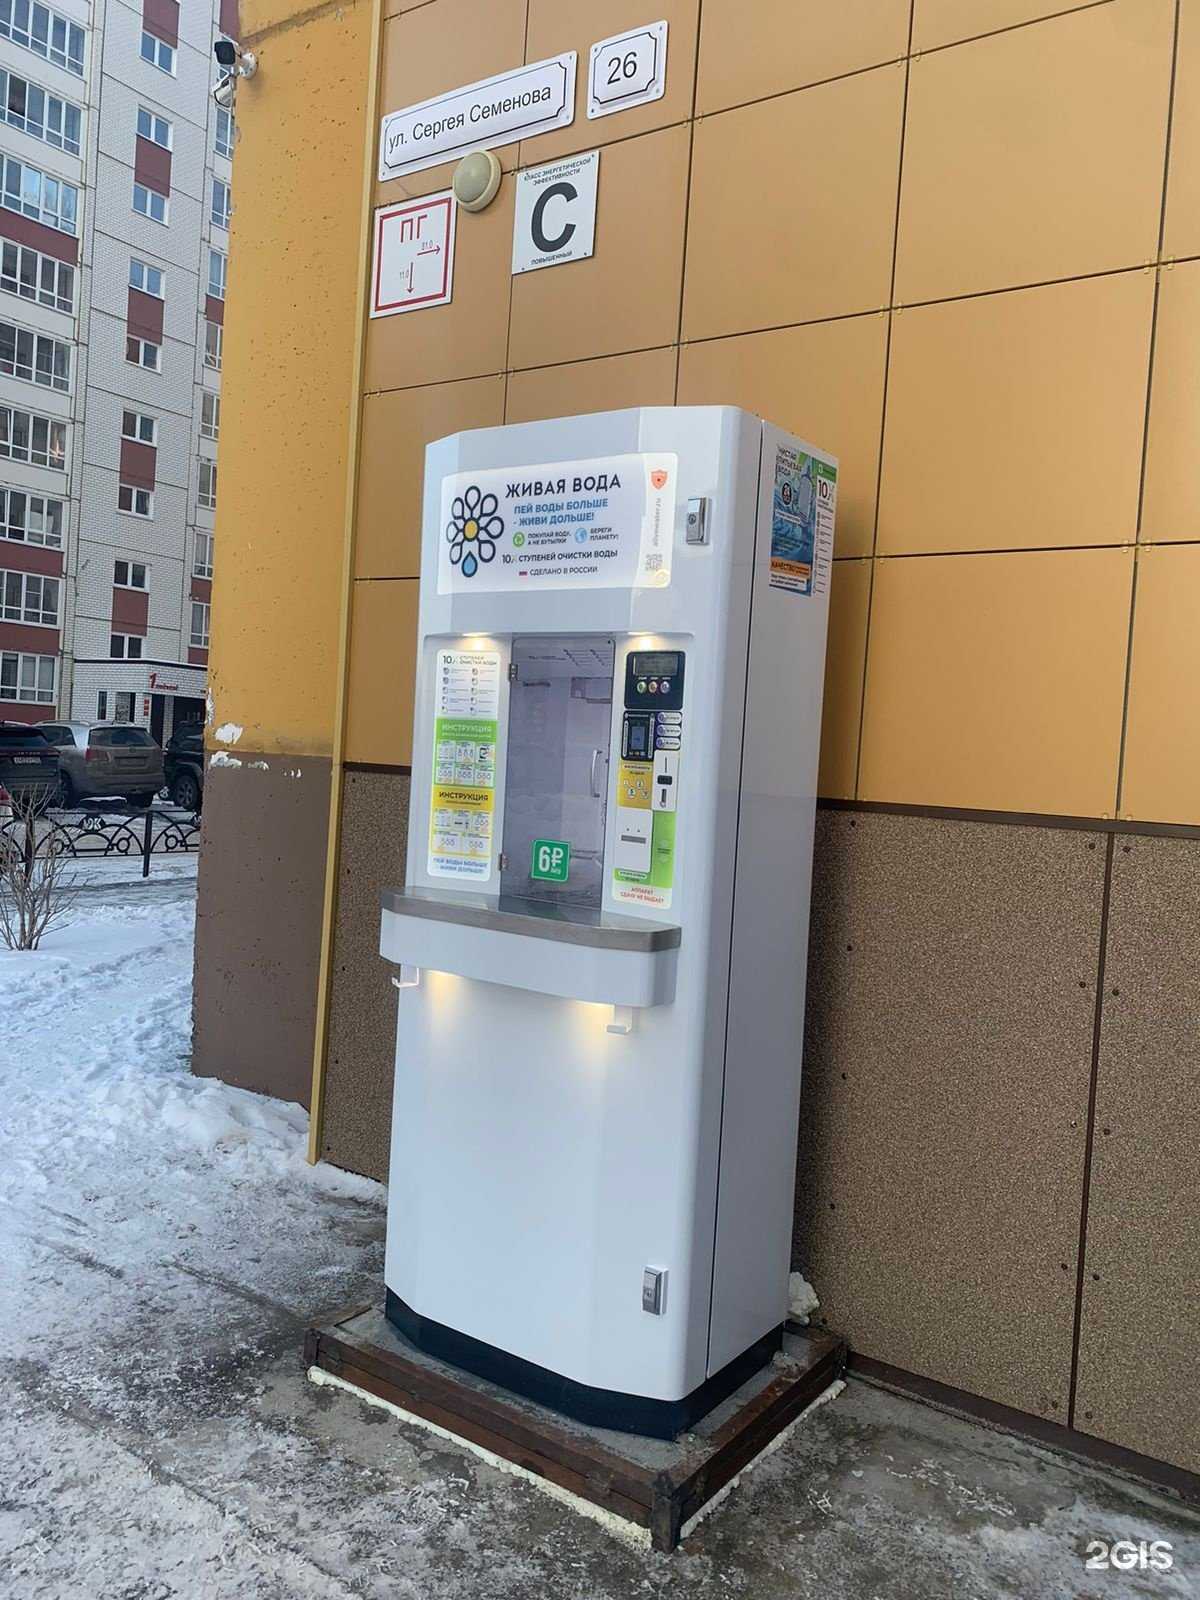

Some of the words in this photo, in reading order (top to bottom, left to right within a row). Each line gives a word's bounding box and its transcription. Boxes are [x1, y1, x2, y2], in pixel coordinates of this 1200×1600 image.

[607, 51, 638, 85] 26
[388, 130, 408, 154] ул.
[412, 113, 465, 141] Сергея
[469, 86, 551, 123] Семенова
[400, 214, 428, 243] ПГ
[505, 479, 566, 498] ЖИВАЯ
[572, 474, 621, 494] ВОДА
[514, 503, 532, 514] ПЕЙ
[535, 502, 565, 514] ВОДЫ
[566, 498, 608, 511] БОЛЬШЕ
[519, 514, 548, 526] ЖИВИ
[549, 512, 594, 526] ДОЛЬШЕ!
[519, 553, 556, 562] СТУПЕНЕЙ
[558, 552, 592, 560] ОЧИСТКИ
[594, 550, 618, 560] ВОДЫ
[530, 568, 562, 576] СДЕЛАНО
[440, 792, 488, 800] ИНСТРУКЦИЯ
